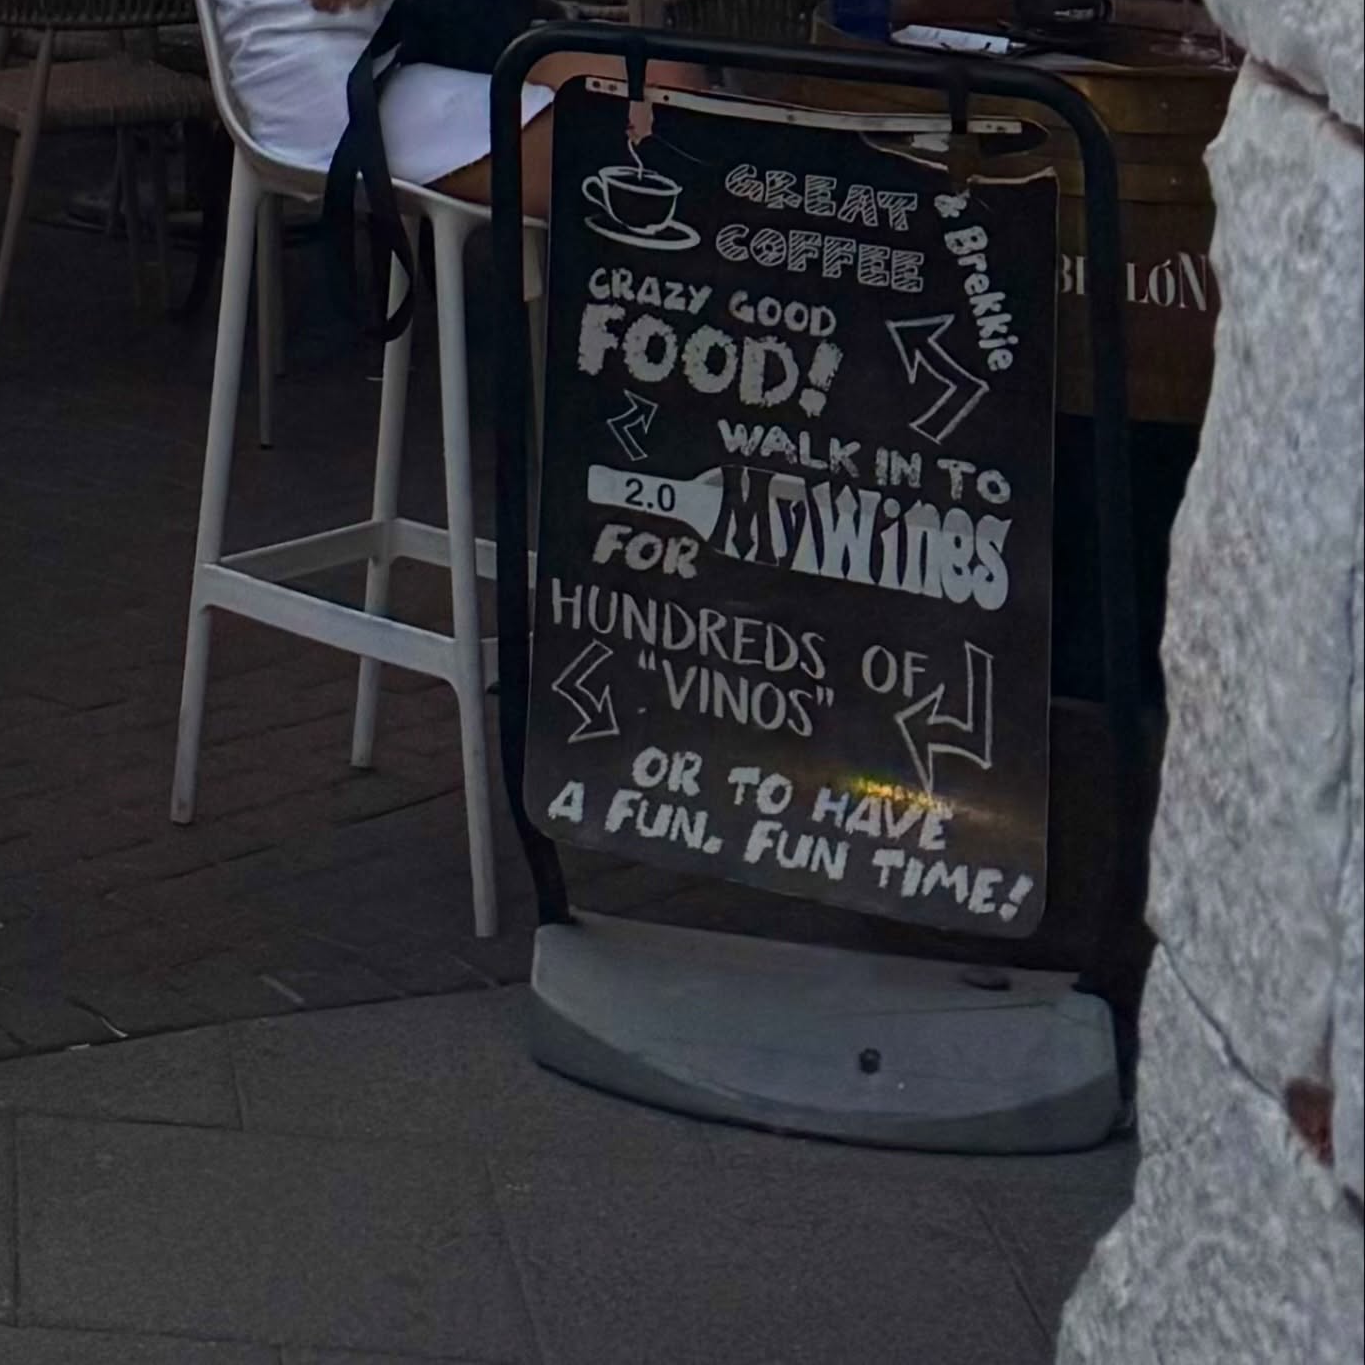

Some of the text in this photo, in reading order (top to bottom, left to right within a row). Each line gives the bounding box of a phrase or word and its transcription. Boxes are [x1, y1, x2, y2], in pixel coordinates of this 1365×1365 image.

[725, 163, 918, 230] GREAT
[715, 223, 925, 293] COFFEE
[943, 225, 1020, 372] Brekkie
[587, 267, 837, 337] CRAZY GOOD
[577, 303, 844, 418] FOOD!
[624, 477, 677, 513] 2.0
[717, 418, 1012, 505] WALK IN TO
[591, 523, 700, 579] FOR
[550, 577, 929, 696] HUNDREDS OF
[631, 745, 955, 851] OR TO HAVE
[548, 780, 585, 823] A
[743, 820, 851, 880] FUN
[872, 848, 1034, 922] TIME!
